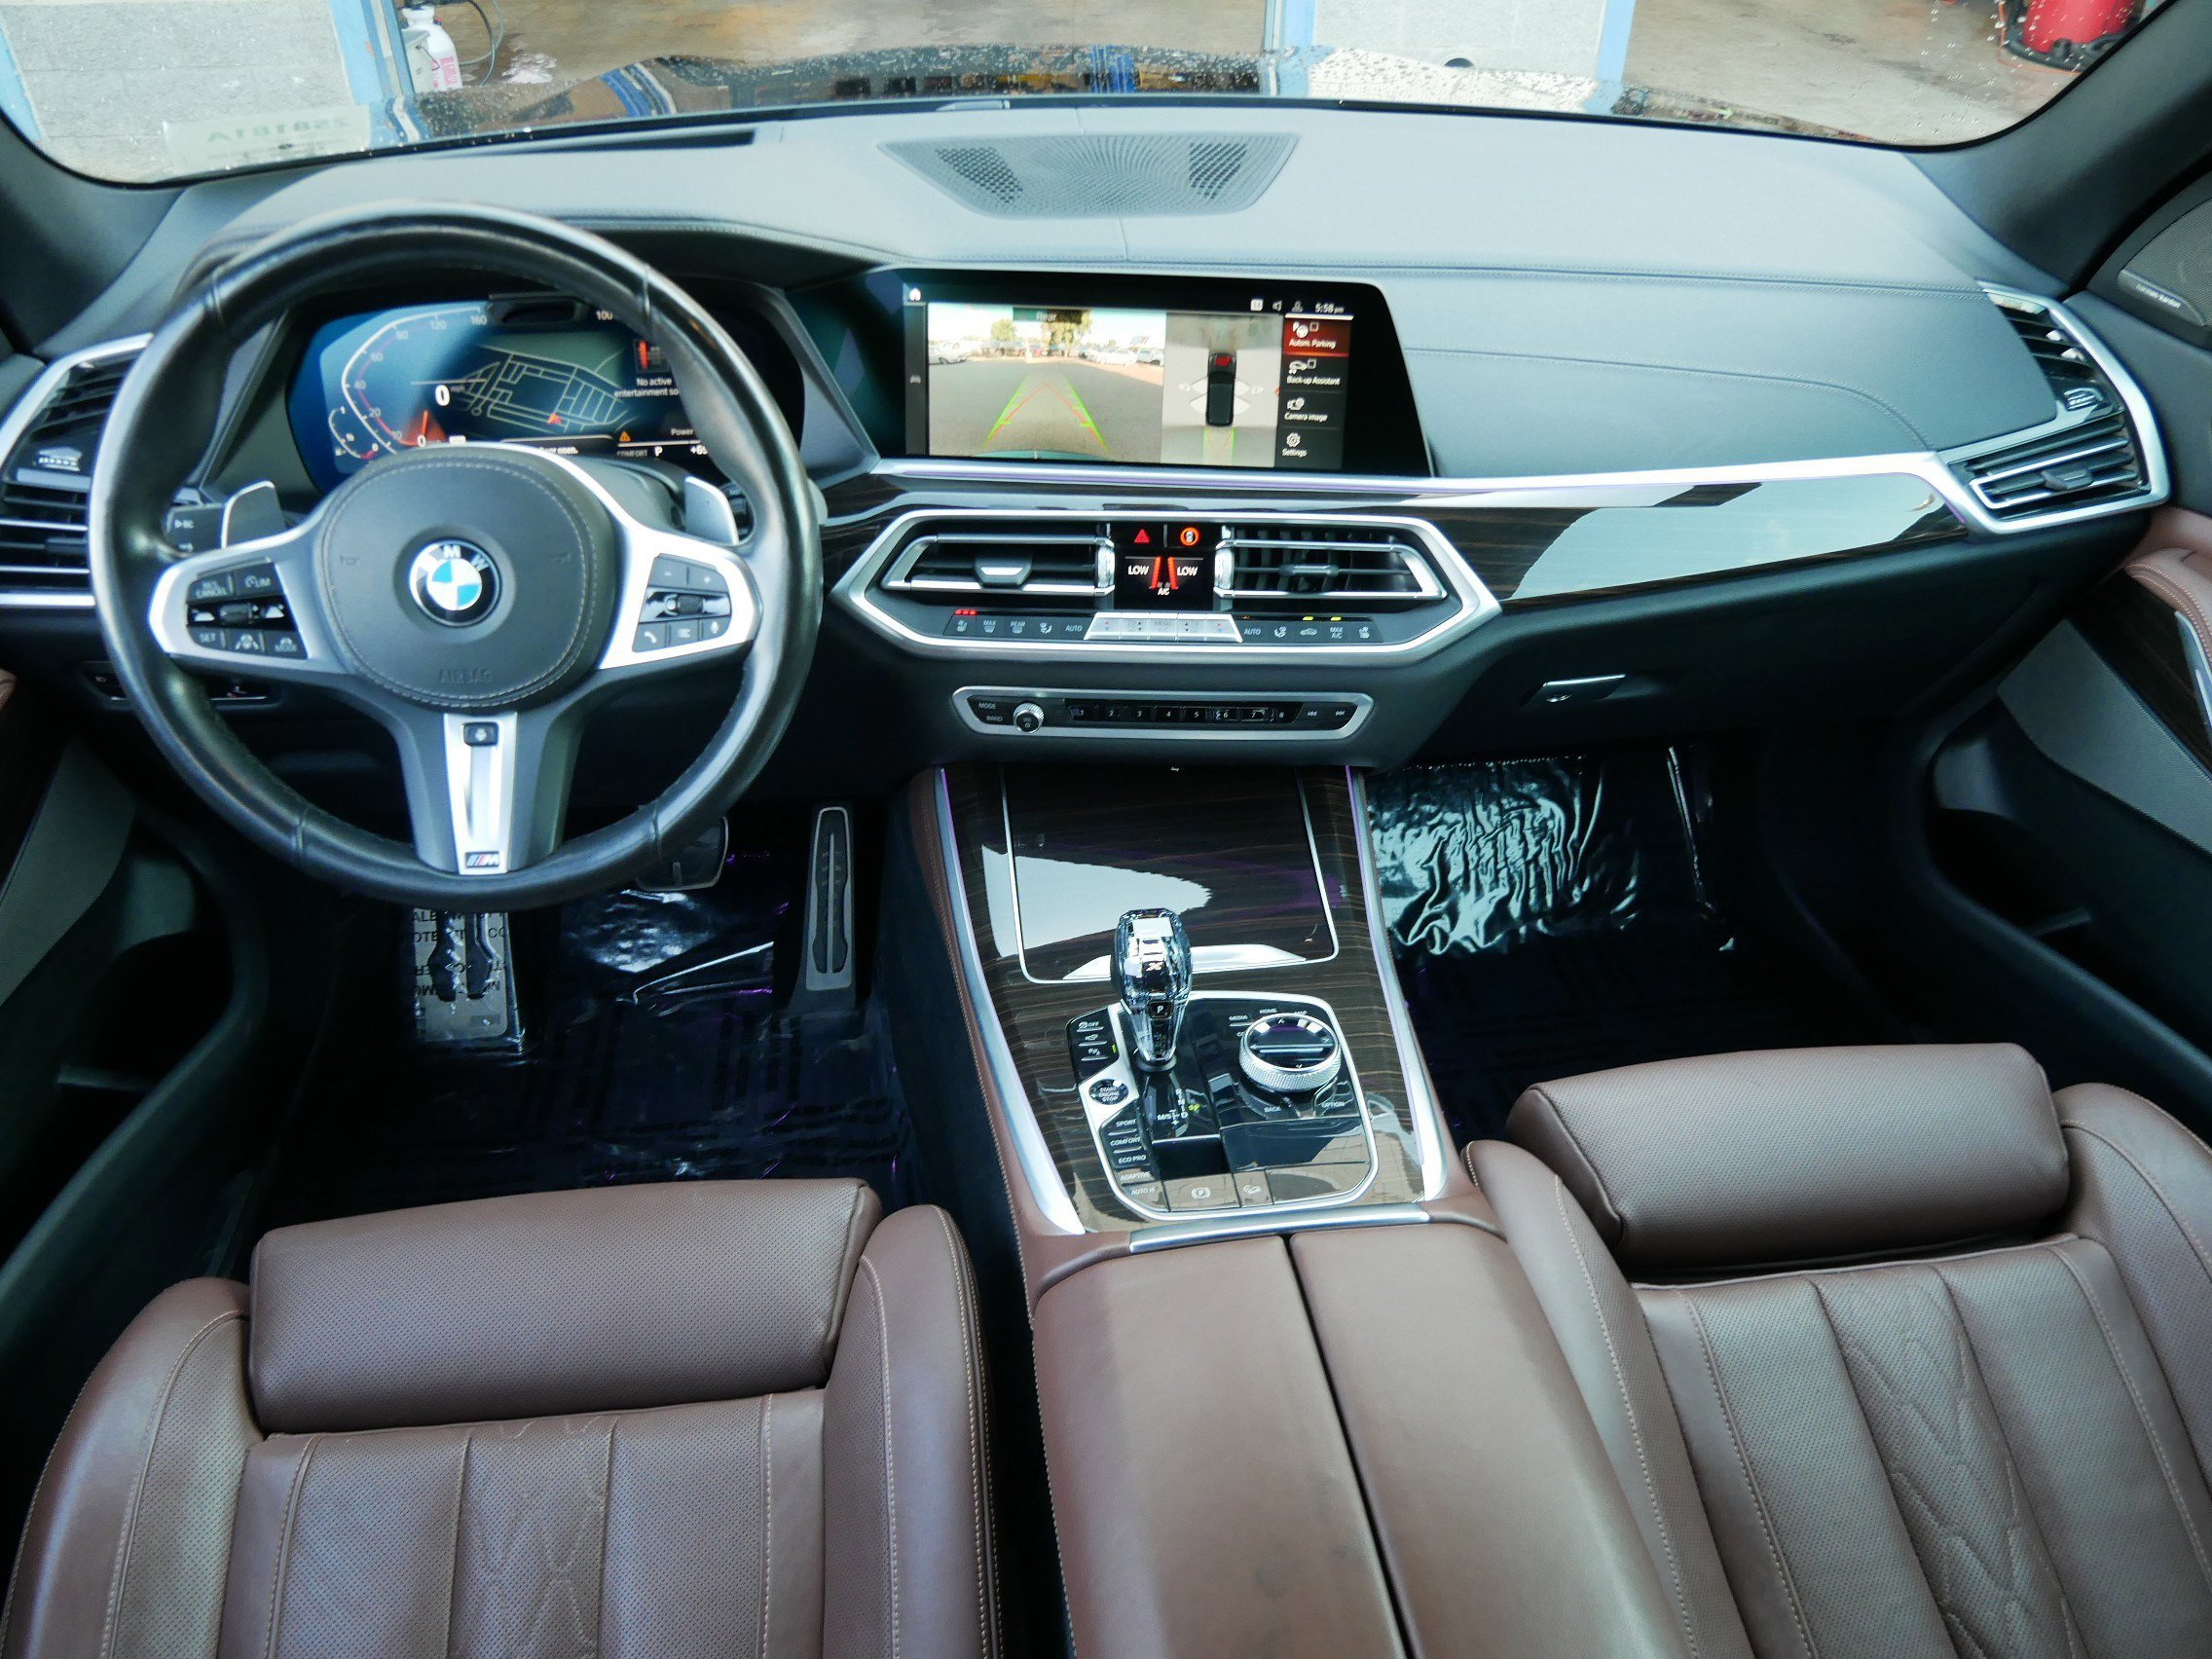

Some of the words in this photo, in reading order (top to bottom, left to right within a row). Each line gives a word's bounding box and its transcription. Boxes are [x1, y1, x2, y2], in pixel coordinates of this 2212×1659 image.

[434, 384, 451, 407] 0
[1127, 565, 1150, 575] LOW
[1176, 566, 1198, 576] LOW
[1065, 624, 1084, 633] AUTO
[1243, 627, 1262, 636] AUTO
[1115, 1119, 1137, 1127] SPORT
[1110, 1136, 1141, 1147] COMFORT
